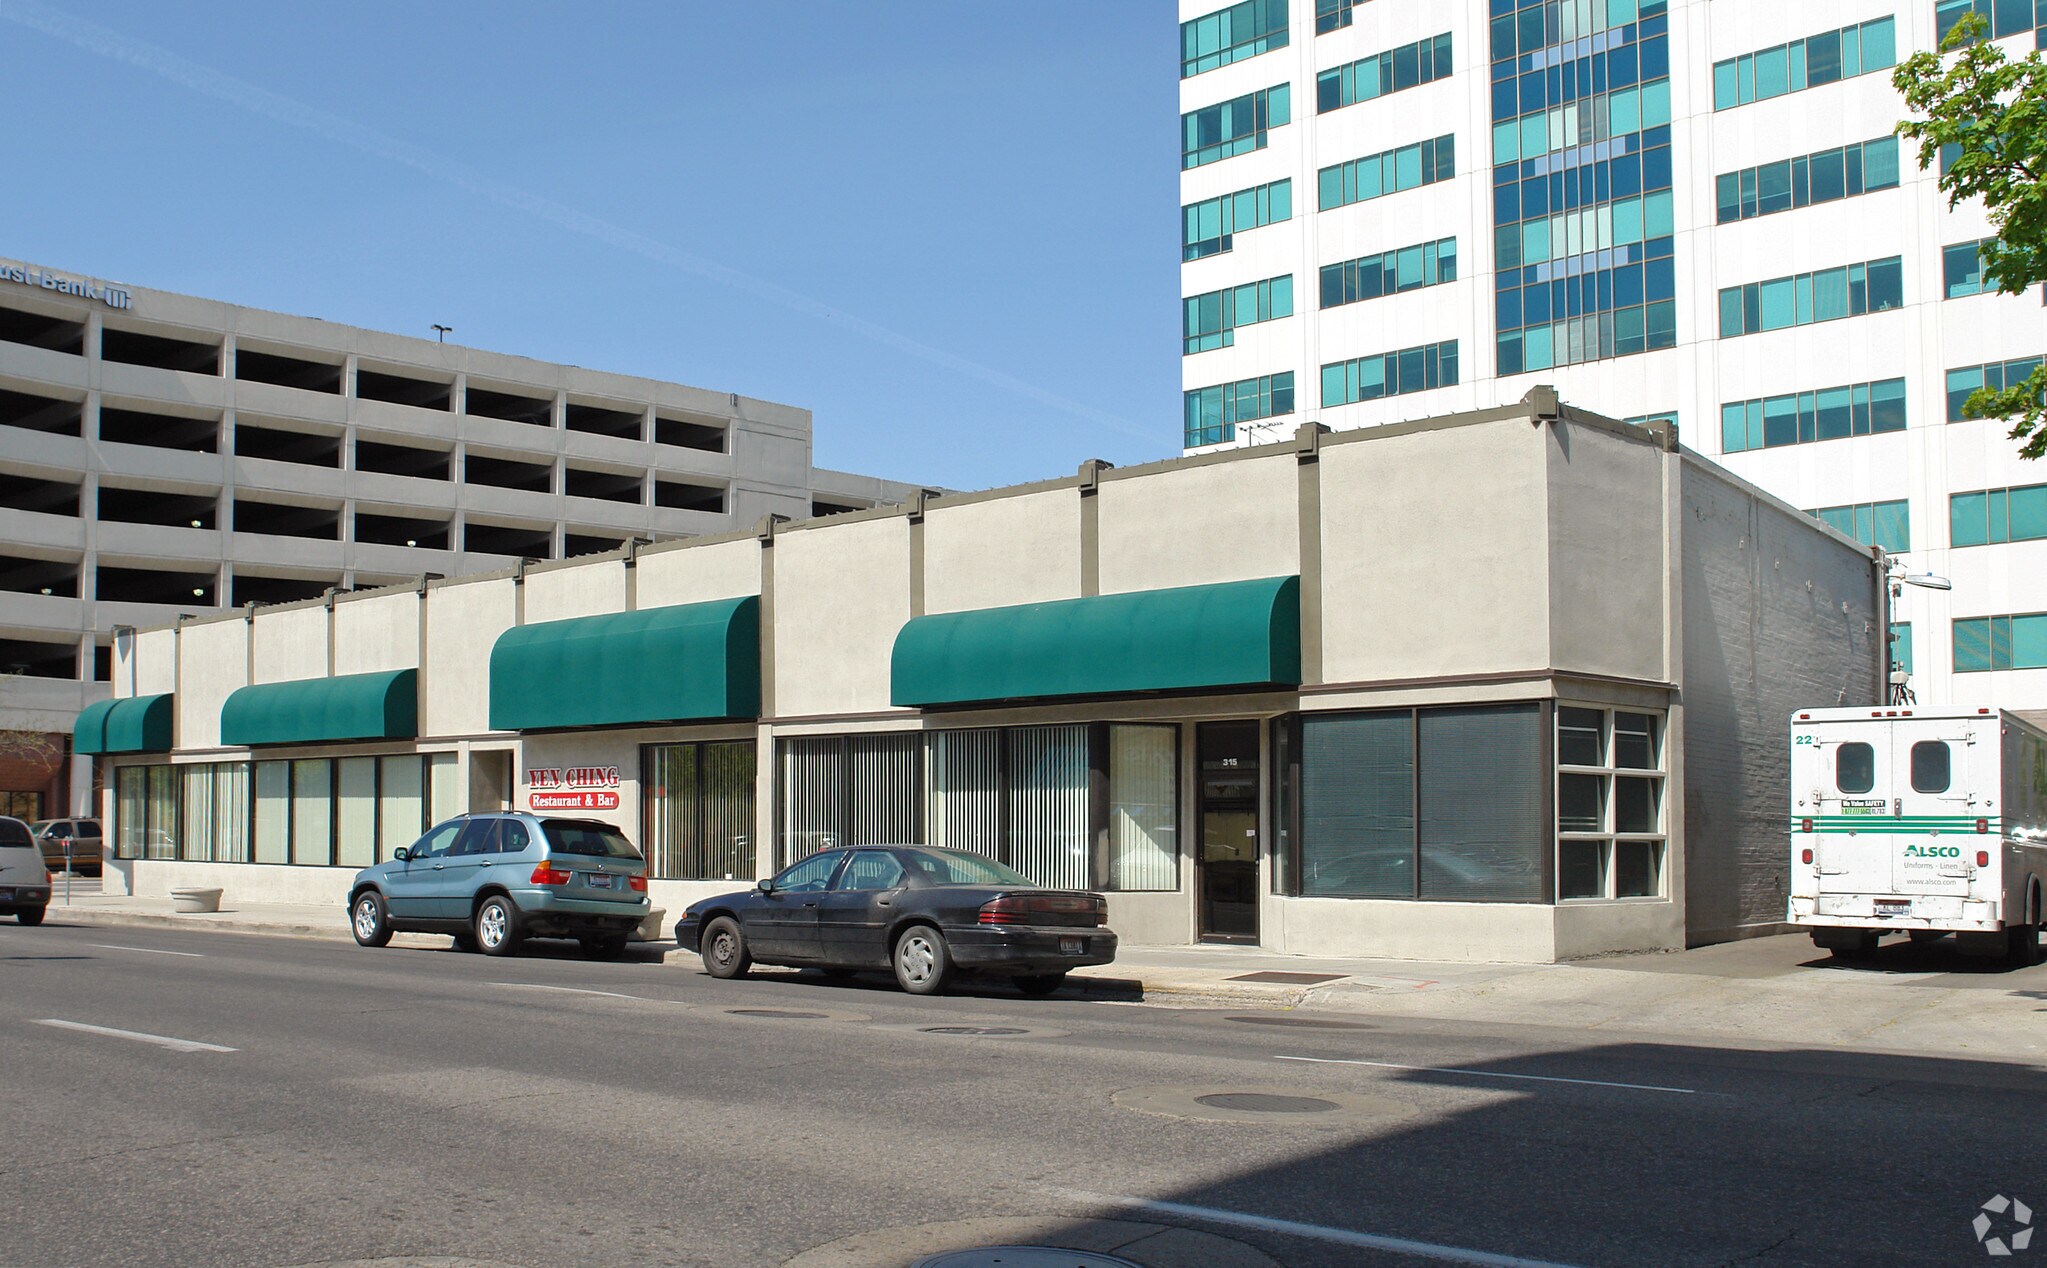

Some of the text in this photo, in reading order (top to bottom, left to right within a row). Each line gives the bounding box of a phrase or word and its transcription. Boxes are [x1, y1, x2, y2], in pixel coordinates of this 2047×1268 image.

[41, 269, 98, 299] Bank
[1796, 735, 1812, 745] 22
[1222, 758, 1238, 766] 315
[529, 766, 619, 788] YEN CHING
[532, 794, 615, 807] Restaurant & Bar
[1903, 845, 1960, 857] ALSCO
[1904, 861, 1933, 869] Uniforms
[1940, 862, 1958, 870] Linen
[1907, 878, 1957, 886] www.alsco.com
